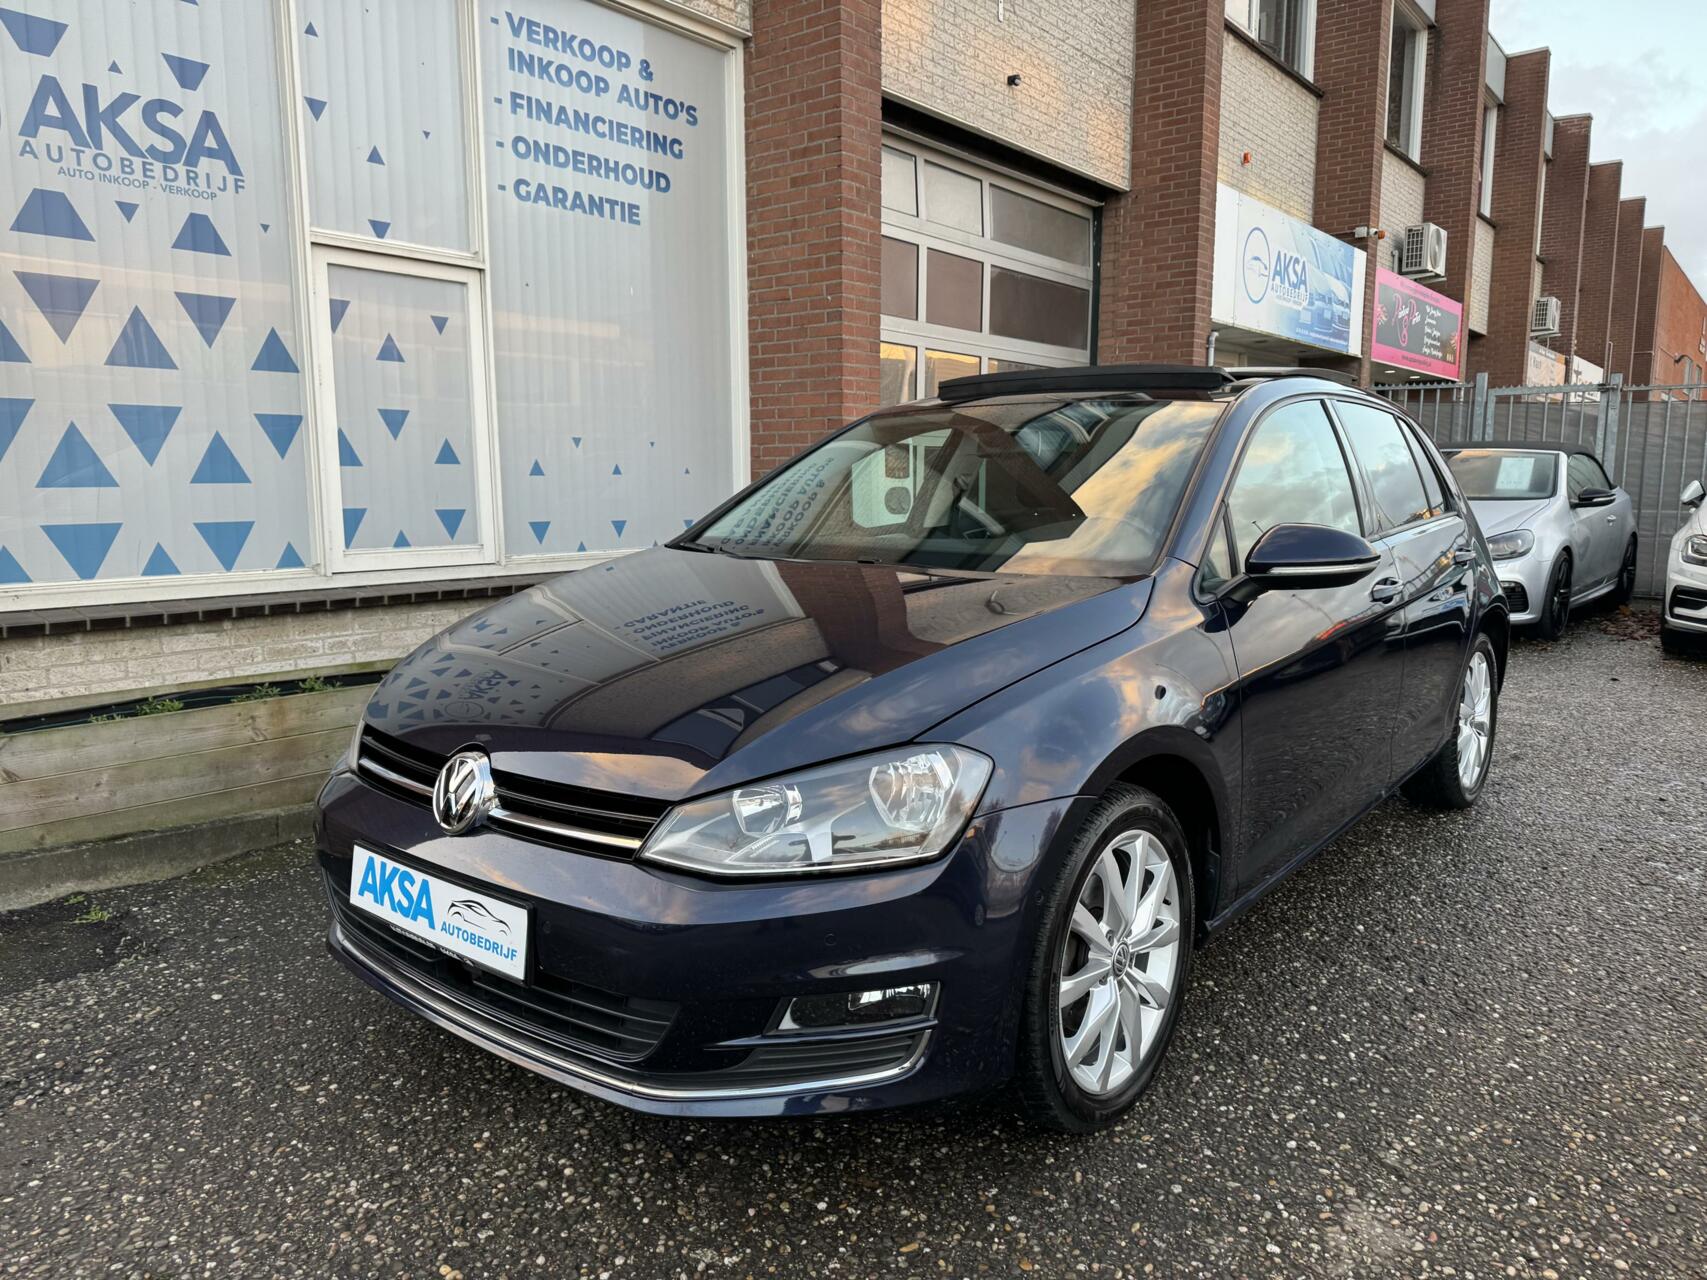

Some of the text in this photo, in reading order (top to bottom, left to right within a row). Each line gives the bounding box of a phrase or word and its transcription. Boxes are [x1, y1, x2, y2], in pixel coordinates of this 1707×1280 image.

[505, 11, 632, 72] VERKOOP
[638, 59, 654, 82] &
[507, 47, 698, 127] INKOOP AUTO'S
[18, 74, 244, 177] AKSA
[510, 91, 683, 160] FINANCIERING
[18, 139, 245, 195] AUTOBEDRIJF
[57, 166, 95, 181] AUTO
[99, 173, 149, 190] INKOOP
[160, 183, 218, 201] VERKOOP
[511, 135, 671, 194] ONDERHOUD
[513, 178, 641, 226] GARANTIE
[1272, 250, 1308, 293] AKSA
[358, 855, 436, 930] AKSA
[440, 921, 518, 961] AUTOBEDRIJF
